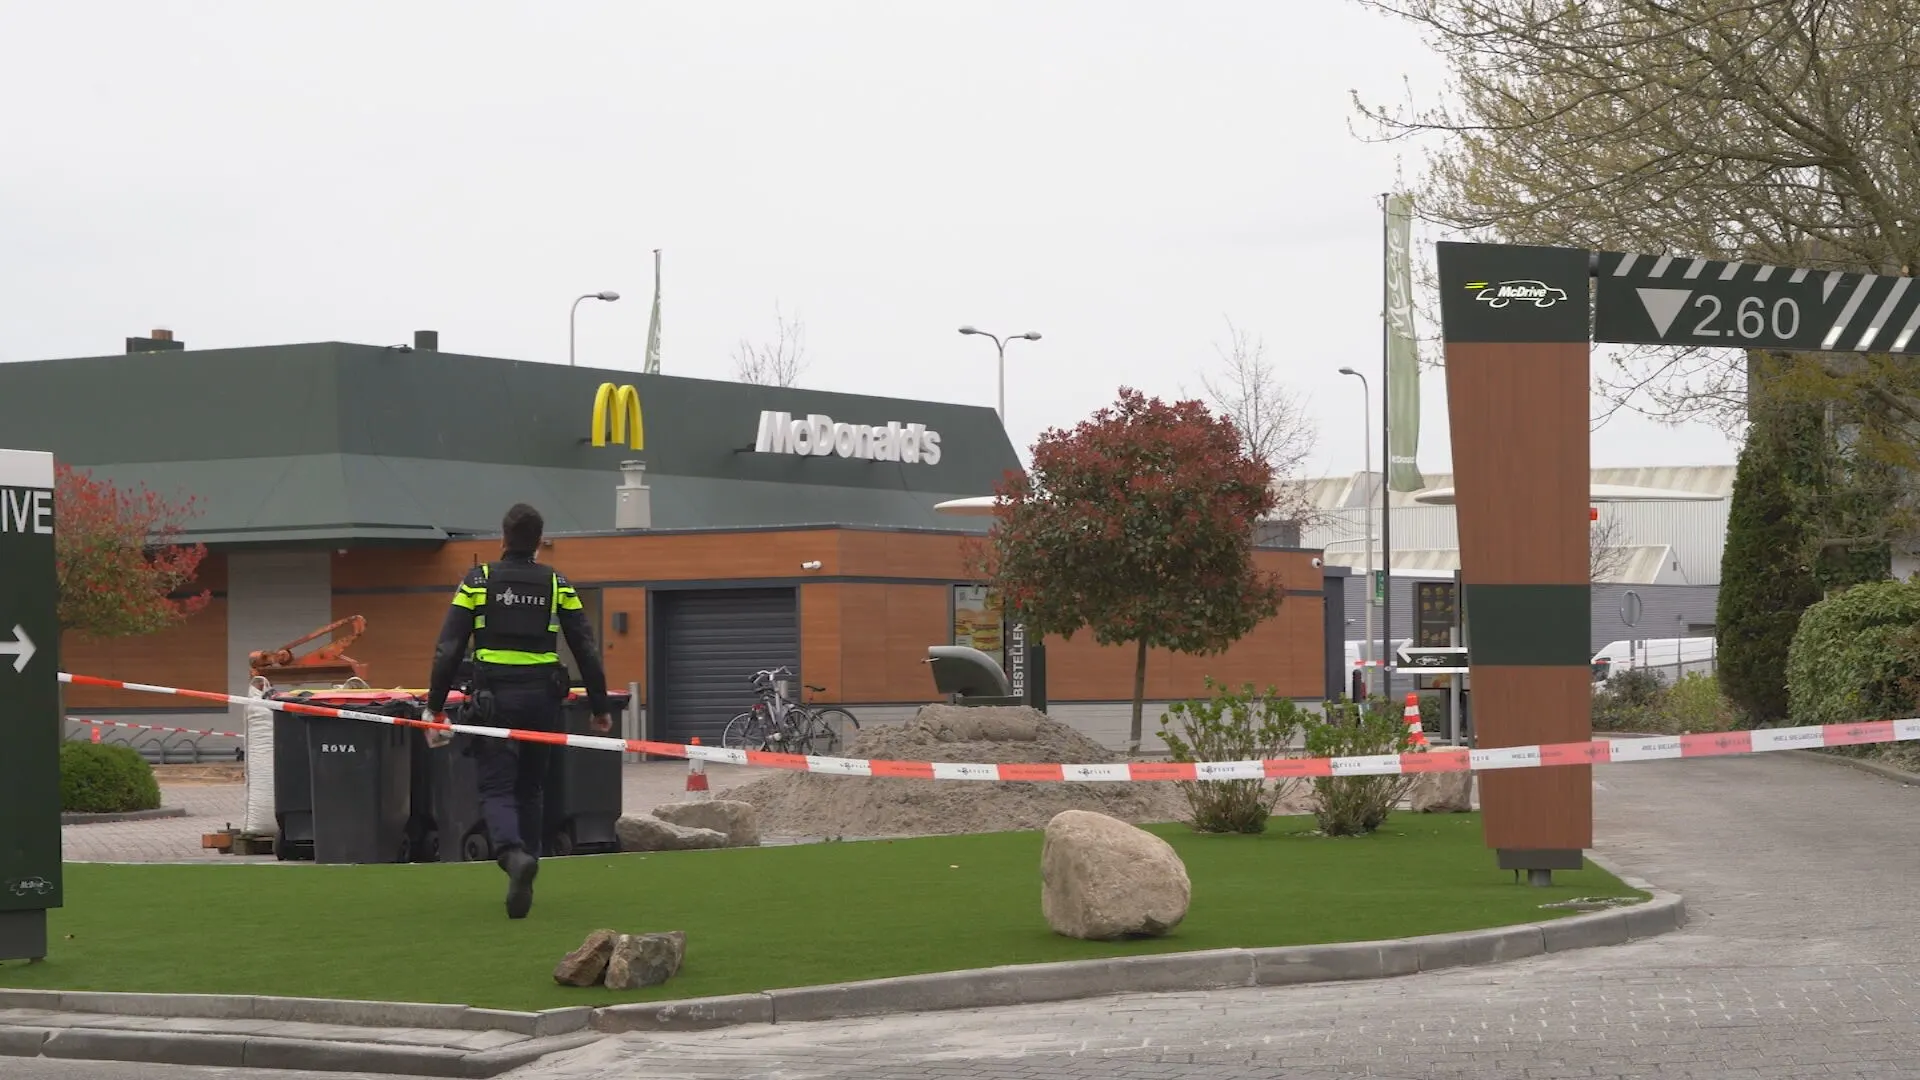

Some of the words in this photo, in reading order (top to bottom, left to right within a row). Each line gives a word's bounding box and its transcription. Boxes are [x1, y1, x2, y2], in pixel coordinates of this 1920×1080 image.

[1498, 286, 1547, 298] McDrive
[1692, 295, 1800, 340] 2.60
[755, 410, 941, 466] McDonald's
[495, 587, 546, 606] POLITIE
[1012, 623, 1024, 697] BESTELLEN
[321, 743, 356, 753] ROVA
